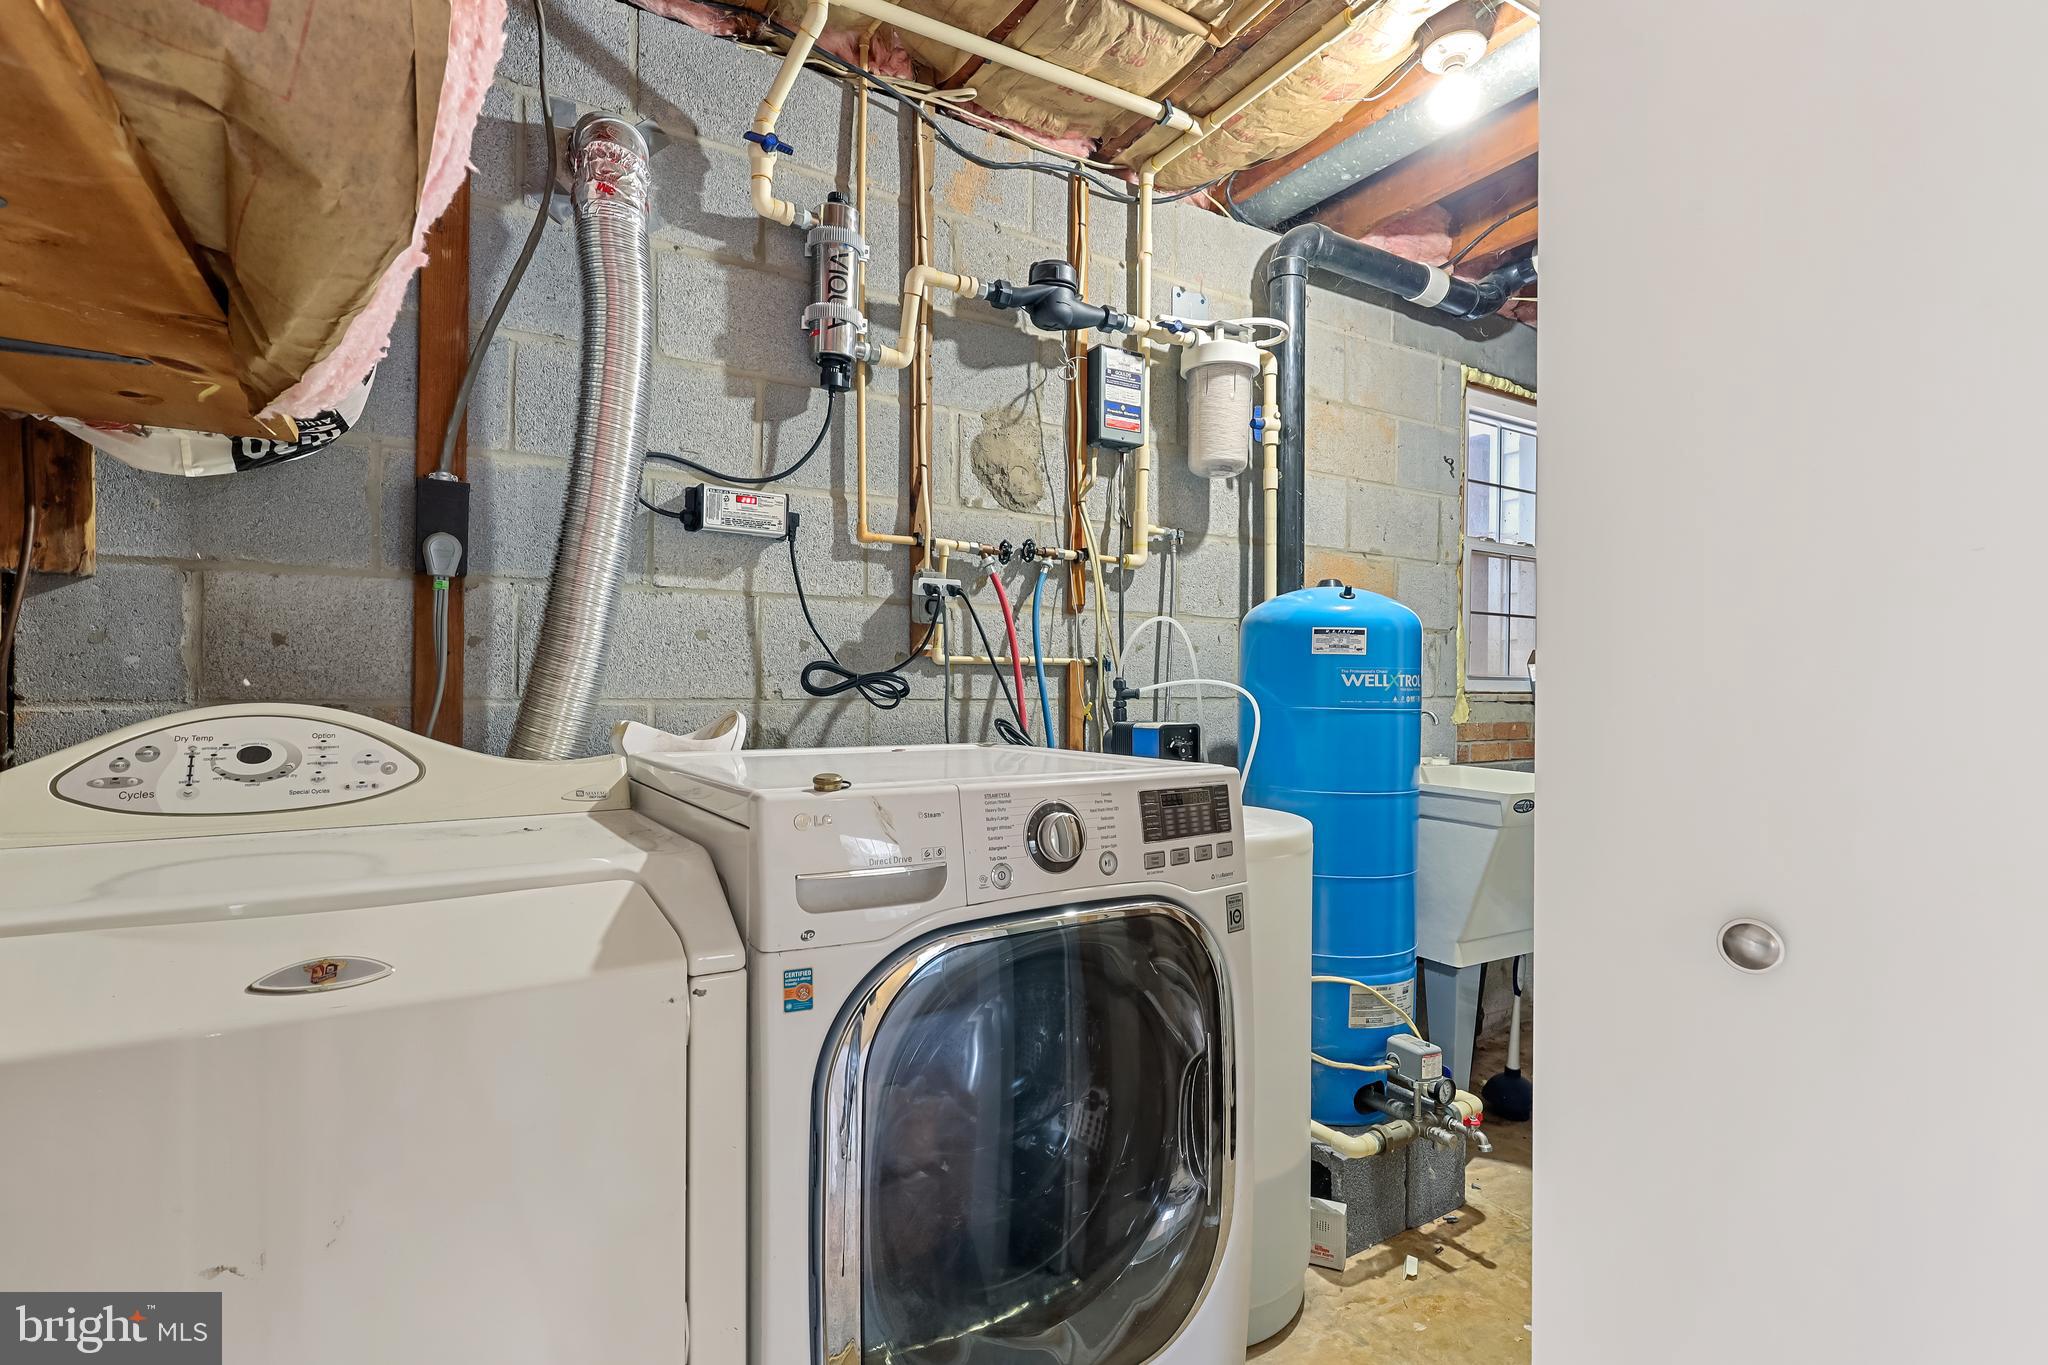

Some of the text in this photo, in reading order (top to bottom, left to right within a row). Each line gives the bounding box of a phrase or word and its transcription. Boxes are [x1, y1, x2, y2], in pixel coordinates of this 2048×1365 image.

[827, 253, 848, 329] VIQA
[174, 735, 214, 743] Dry Temp
[118, 790, 155, 801] Cycles
[813, 814, 832, 827] LG
[869, 855, 913, 866] Direct Drive
[784, 970, 812, 979] CERTIFIED
